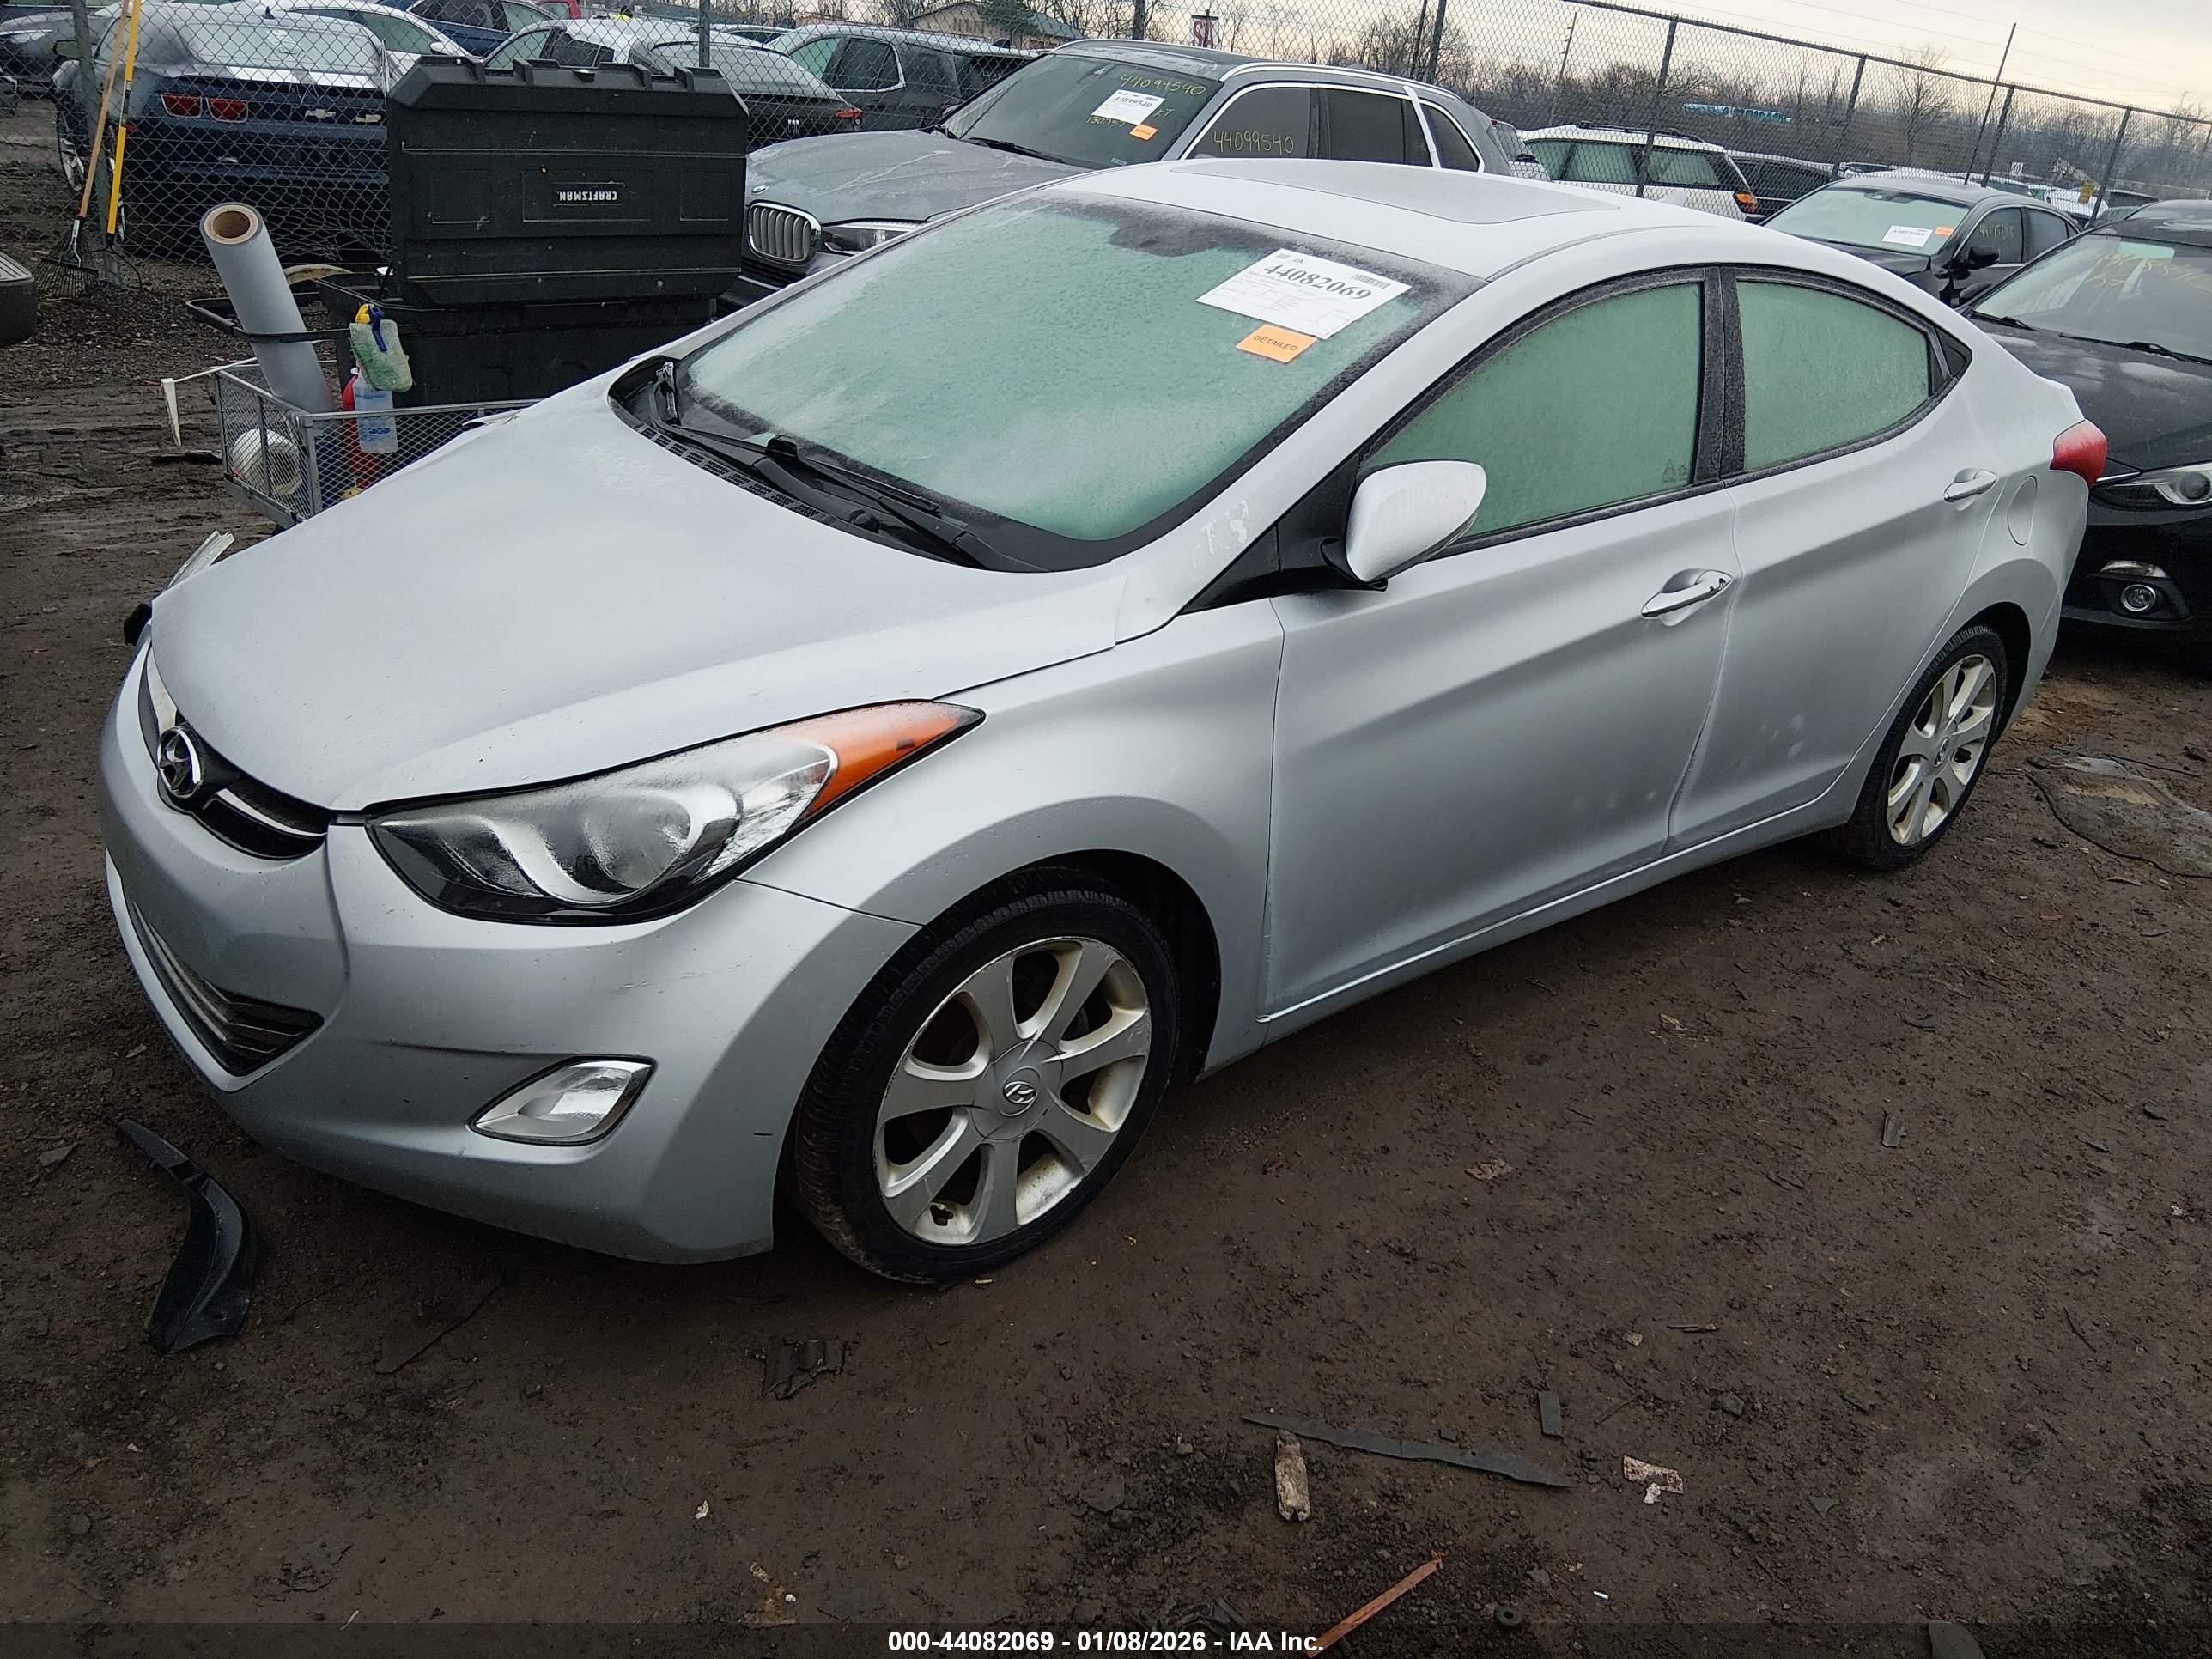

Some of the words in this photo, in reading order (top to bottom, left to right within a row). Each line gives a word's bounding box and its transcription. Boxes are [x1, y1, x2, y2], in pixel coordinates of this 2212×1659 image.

[1119, 74, 1206, 96] 44099540
[1212, 129, 1294, 155] 44099540
[557, 191, 617, 201] CRAFTSMAN
[1263, 264, 1372, 300] 44082069
[1253, 334, 1298, 352] DETAILED
